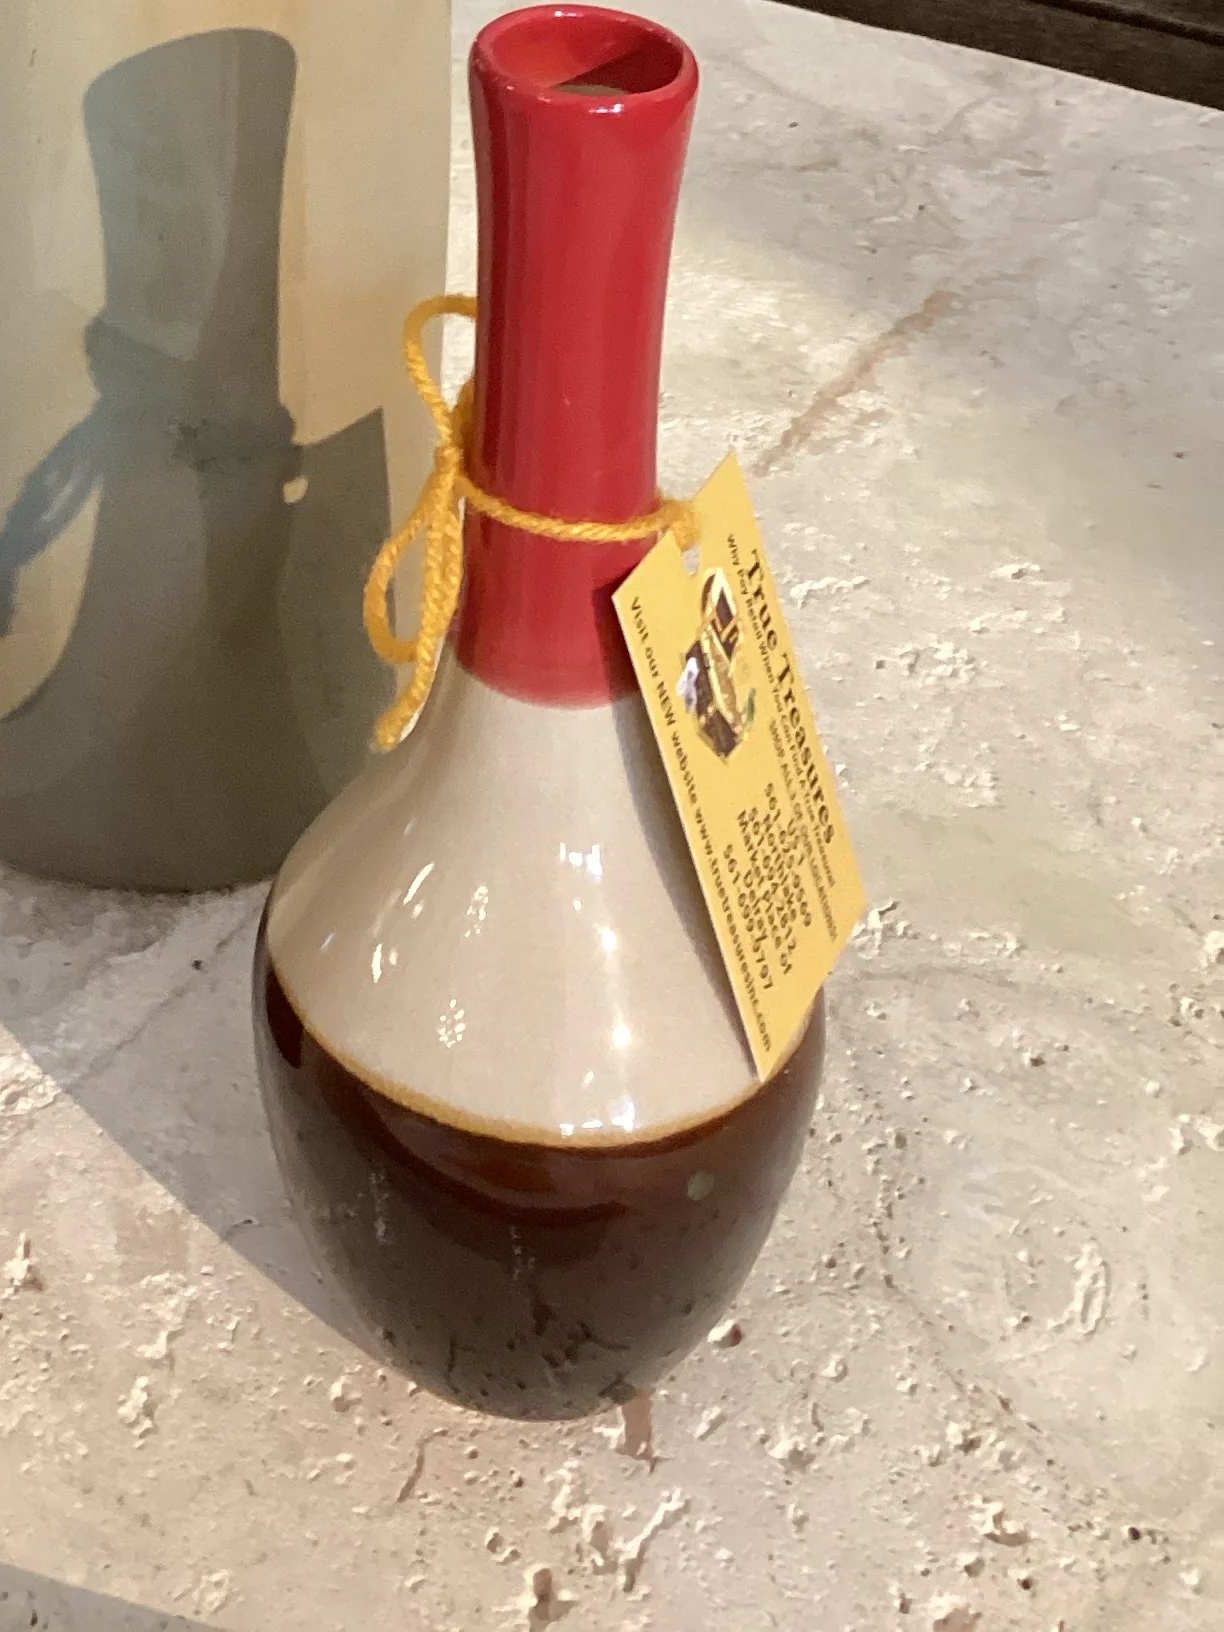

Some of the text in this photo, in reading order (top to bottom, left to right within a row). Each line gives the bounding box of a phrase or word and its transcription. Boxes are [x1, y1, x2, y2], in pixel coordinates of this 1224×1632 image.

[629, 593, 651, 645] Visit
[643, 642, 660, 683] our
[655, 676, 677, 731] NEW
[669, 725, 700, 808] website
[725, 531, 741, 570] Why
[735, 564, 750, 599] Pay
[744, 593, 763, 642] Retail
[758, 638, 776, 686] When
[779, 710, 793, 745] Can
[788, 740, 803, 779] Find
[803, 789, 816, 825] True
[742, 545, 839, 847] True Treasures
[779, 756, 794, 792] ALL
[736, 805, 792, 980] Market Place of
[738, 866, 770, 951] Delray
[761, 811, 800, 925] Northlake
